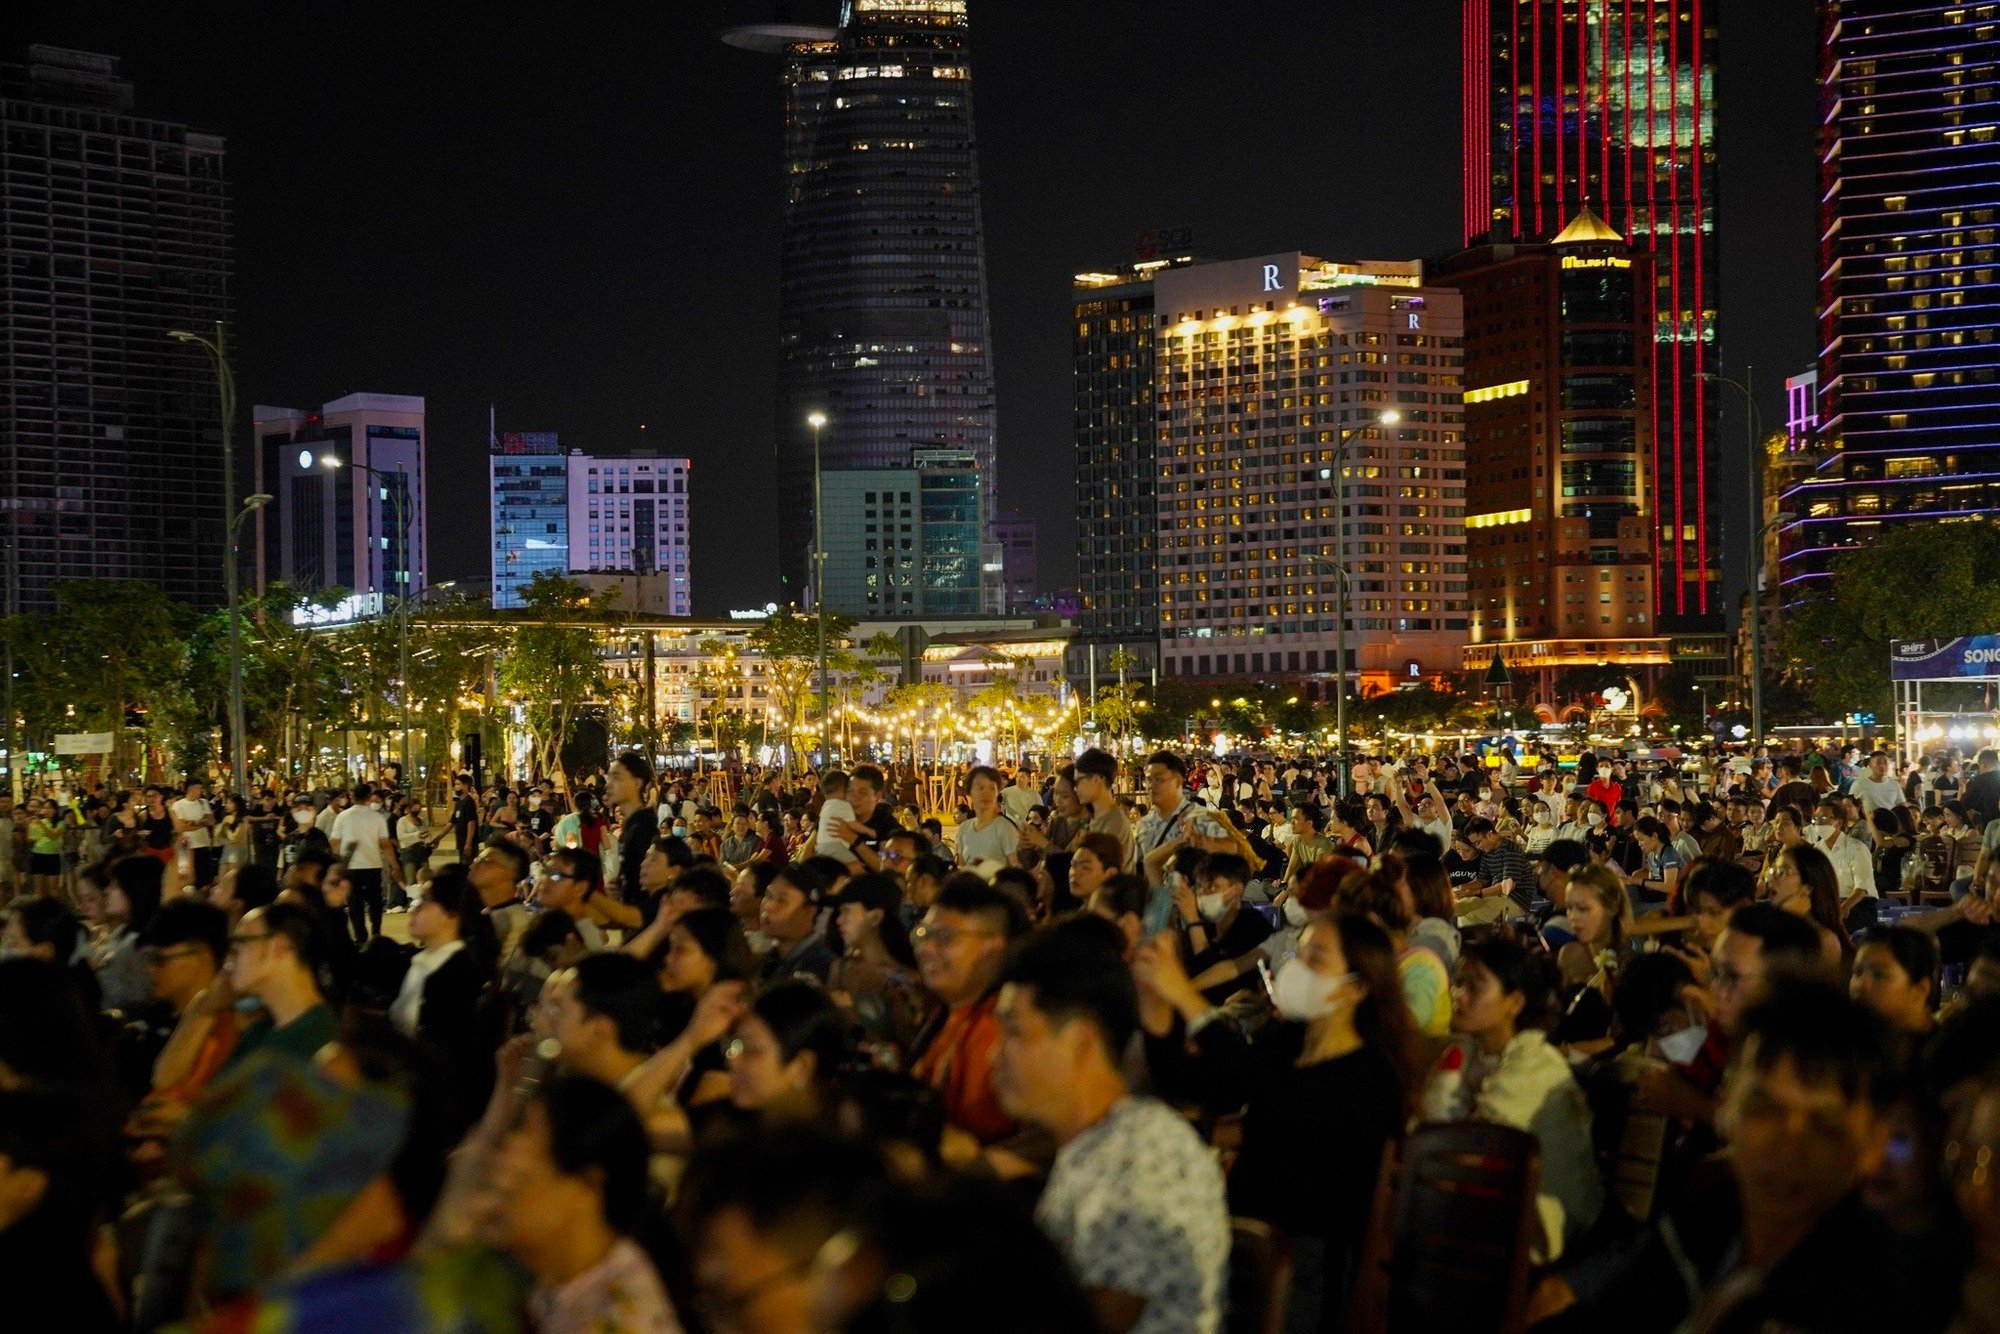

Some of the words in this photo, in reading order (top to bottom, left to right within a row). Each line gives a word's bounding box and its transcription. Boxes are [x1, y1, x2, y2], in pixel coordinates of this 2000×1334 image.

[1263, 264, 1284, 292] R
[1408, 313, 1420, 330] R
[1410, 663, 1420, 676] R
